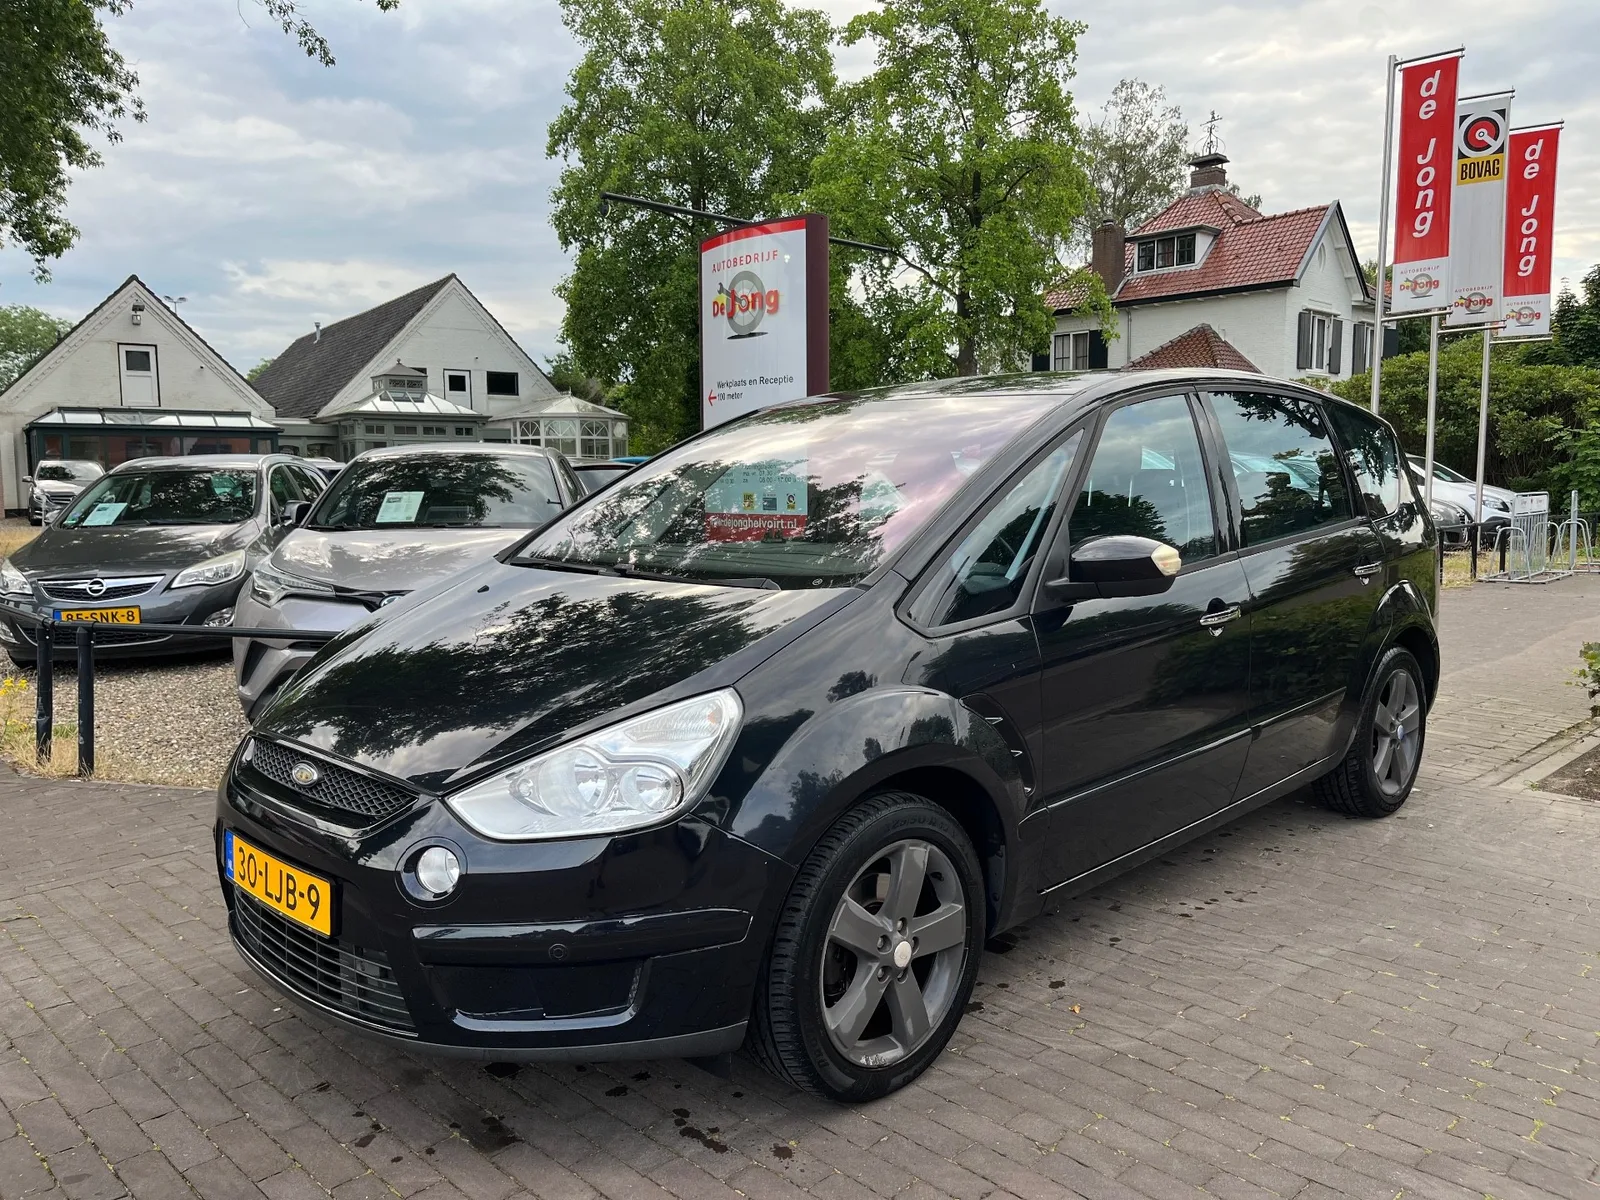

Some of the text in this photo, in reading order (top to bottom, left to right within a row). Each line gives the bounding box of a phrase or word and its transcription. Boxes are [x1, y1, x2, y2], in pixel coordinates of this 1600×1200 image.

[1412, 69, 1441, 239] de Jong
[1460, 158, 1501, 181] BOVAG
[1517, 138, 1544, 277] de Jong
[711, 249, 779, 274] AUTOBEDRIJF
[712, 288, 780, 319] De Jong
[717, 374, 794, 390] Werkplaats en Receptie
[717, 392, 726, 401] 100
[710, 517, 797, 530] dejonghelvoirt.nl
[66, 610, 135, 623] 85-SNK-8
[238, 846, 321, 921] 30-LJB-9
